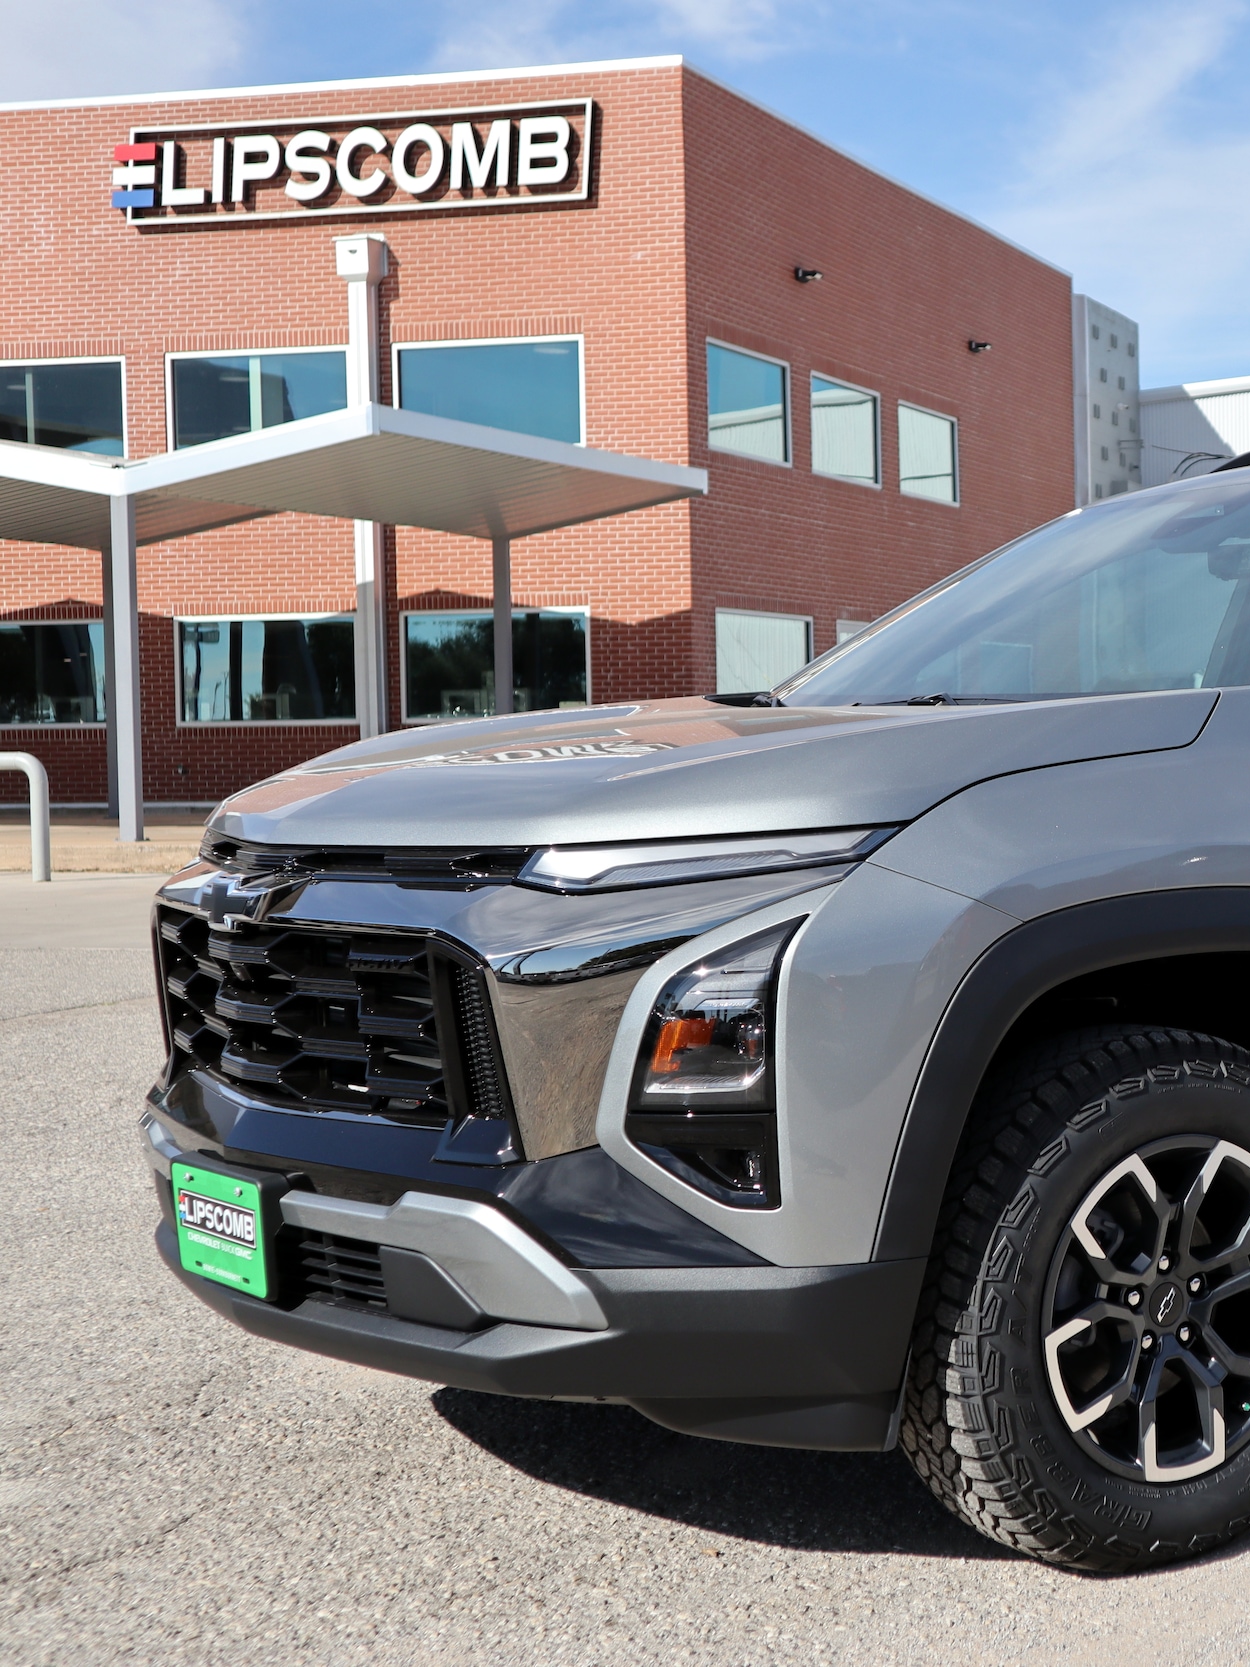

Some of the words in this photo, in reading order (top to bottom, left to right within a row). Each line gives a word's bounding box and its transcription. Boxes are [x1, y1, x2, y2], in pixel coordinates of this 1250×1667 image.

[161, 115, 572, 207] LIPSCOMB
[184, 1196, 255, 1242] LIPSCOMB
[187, 1231, 220, 1250] CHEVROLET
[233, 1246, 253, 1260] GMC
[1009, 1366, 1152, 1532] GRABBER
